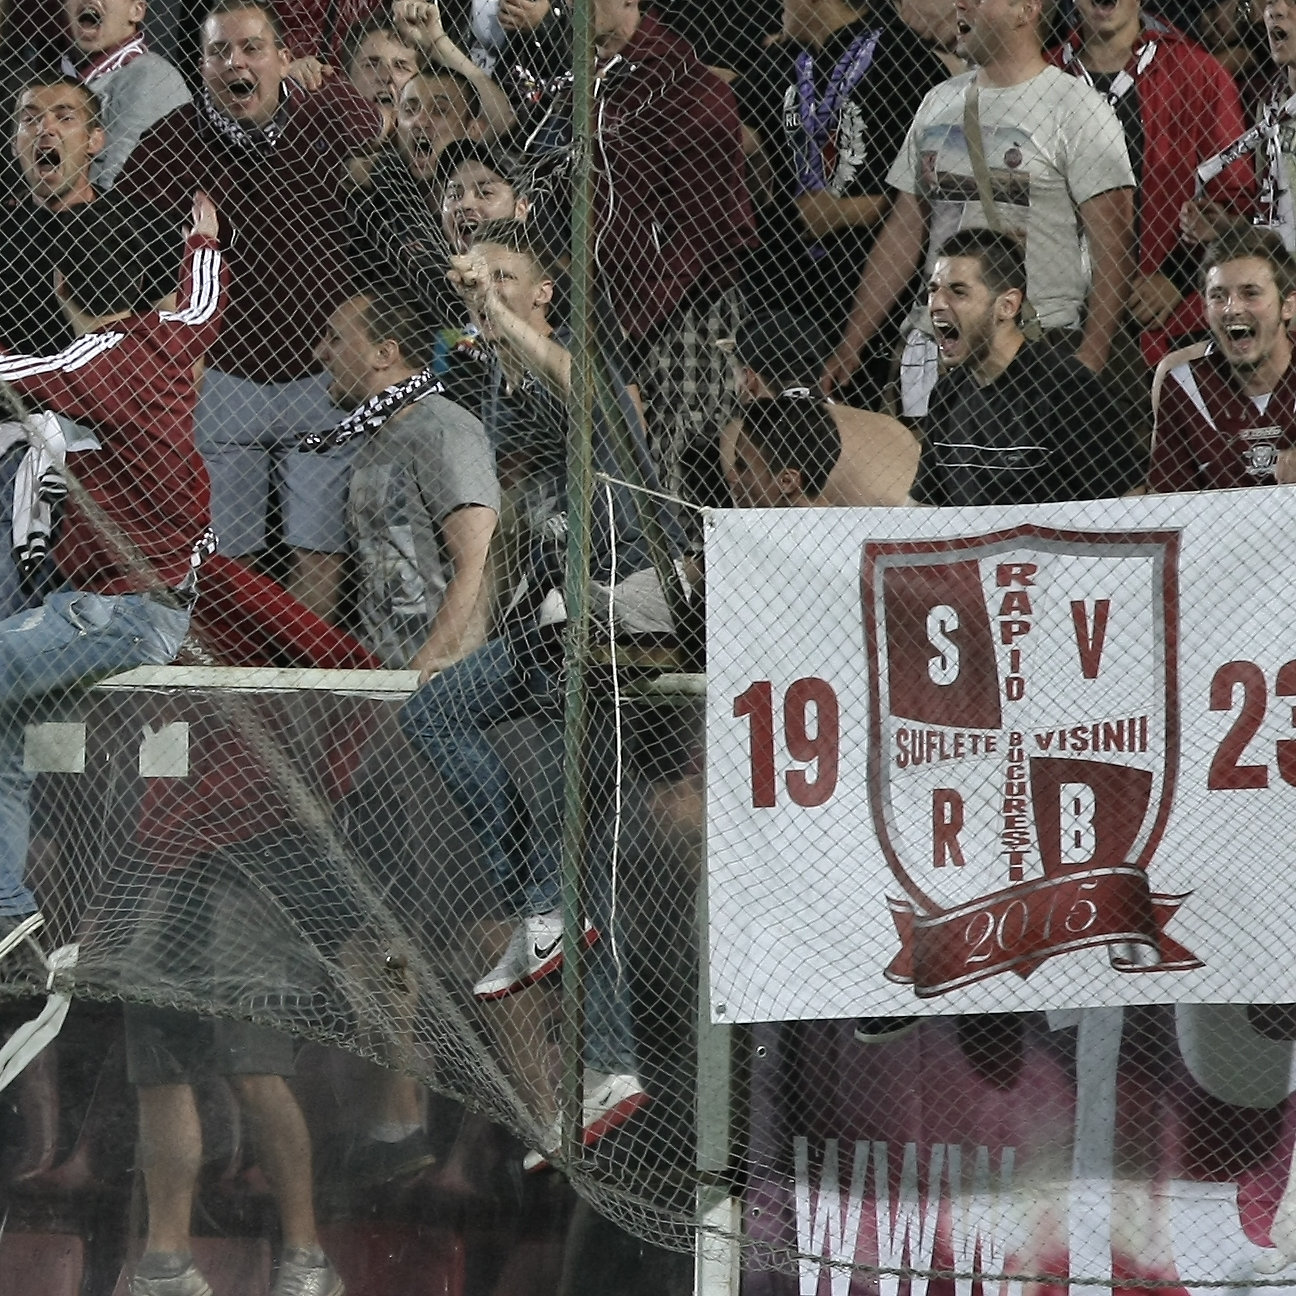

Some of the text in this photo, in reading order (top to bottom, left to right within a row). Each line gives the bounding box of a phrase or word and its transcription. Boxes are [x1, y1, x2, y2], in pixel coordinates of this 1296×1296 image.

[925, 603, 961, 687] S
[995, 563, 1036, 703] RAPID
[1070, 599, 1111, 680] V
[733, 676, 839, 809] 19
[895, 726, 998, 769] SUFLETE
[932, 787, 965, 868] R
[1058, 782, 1098, 866] B
[963, 879, 1100, 965] 2015
